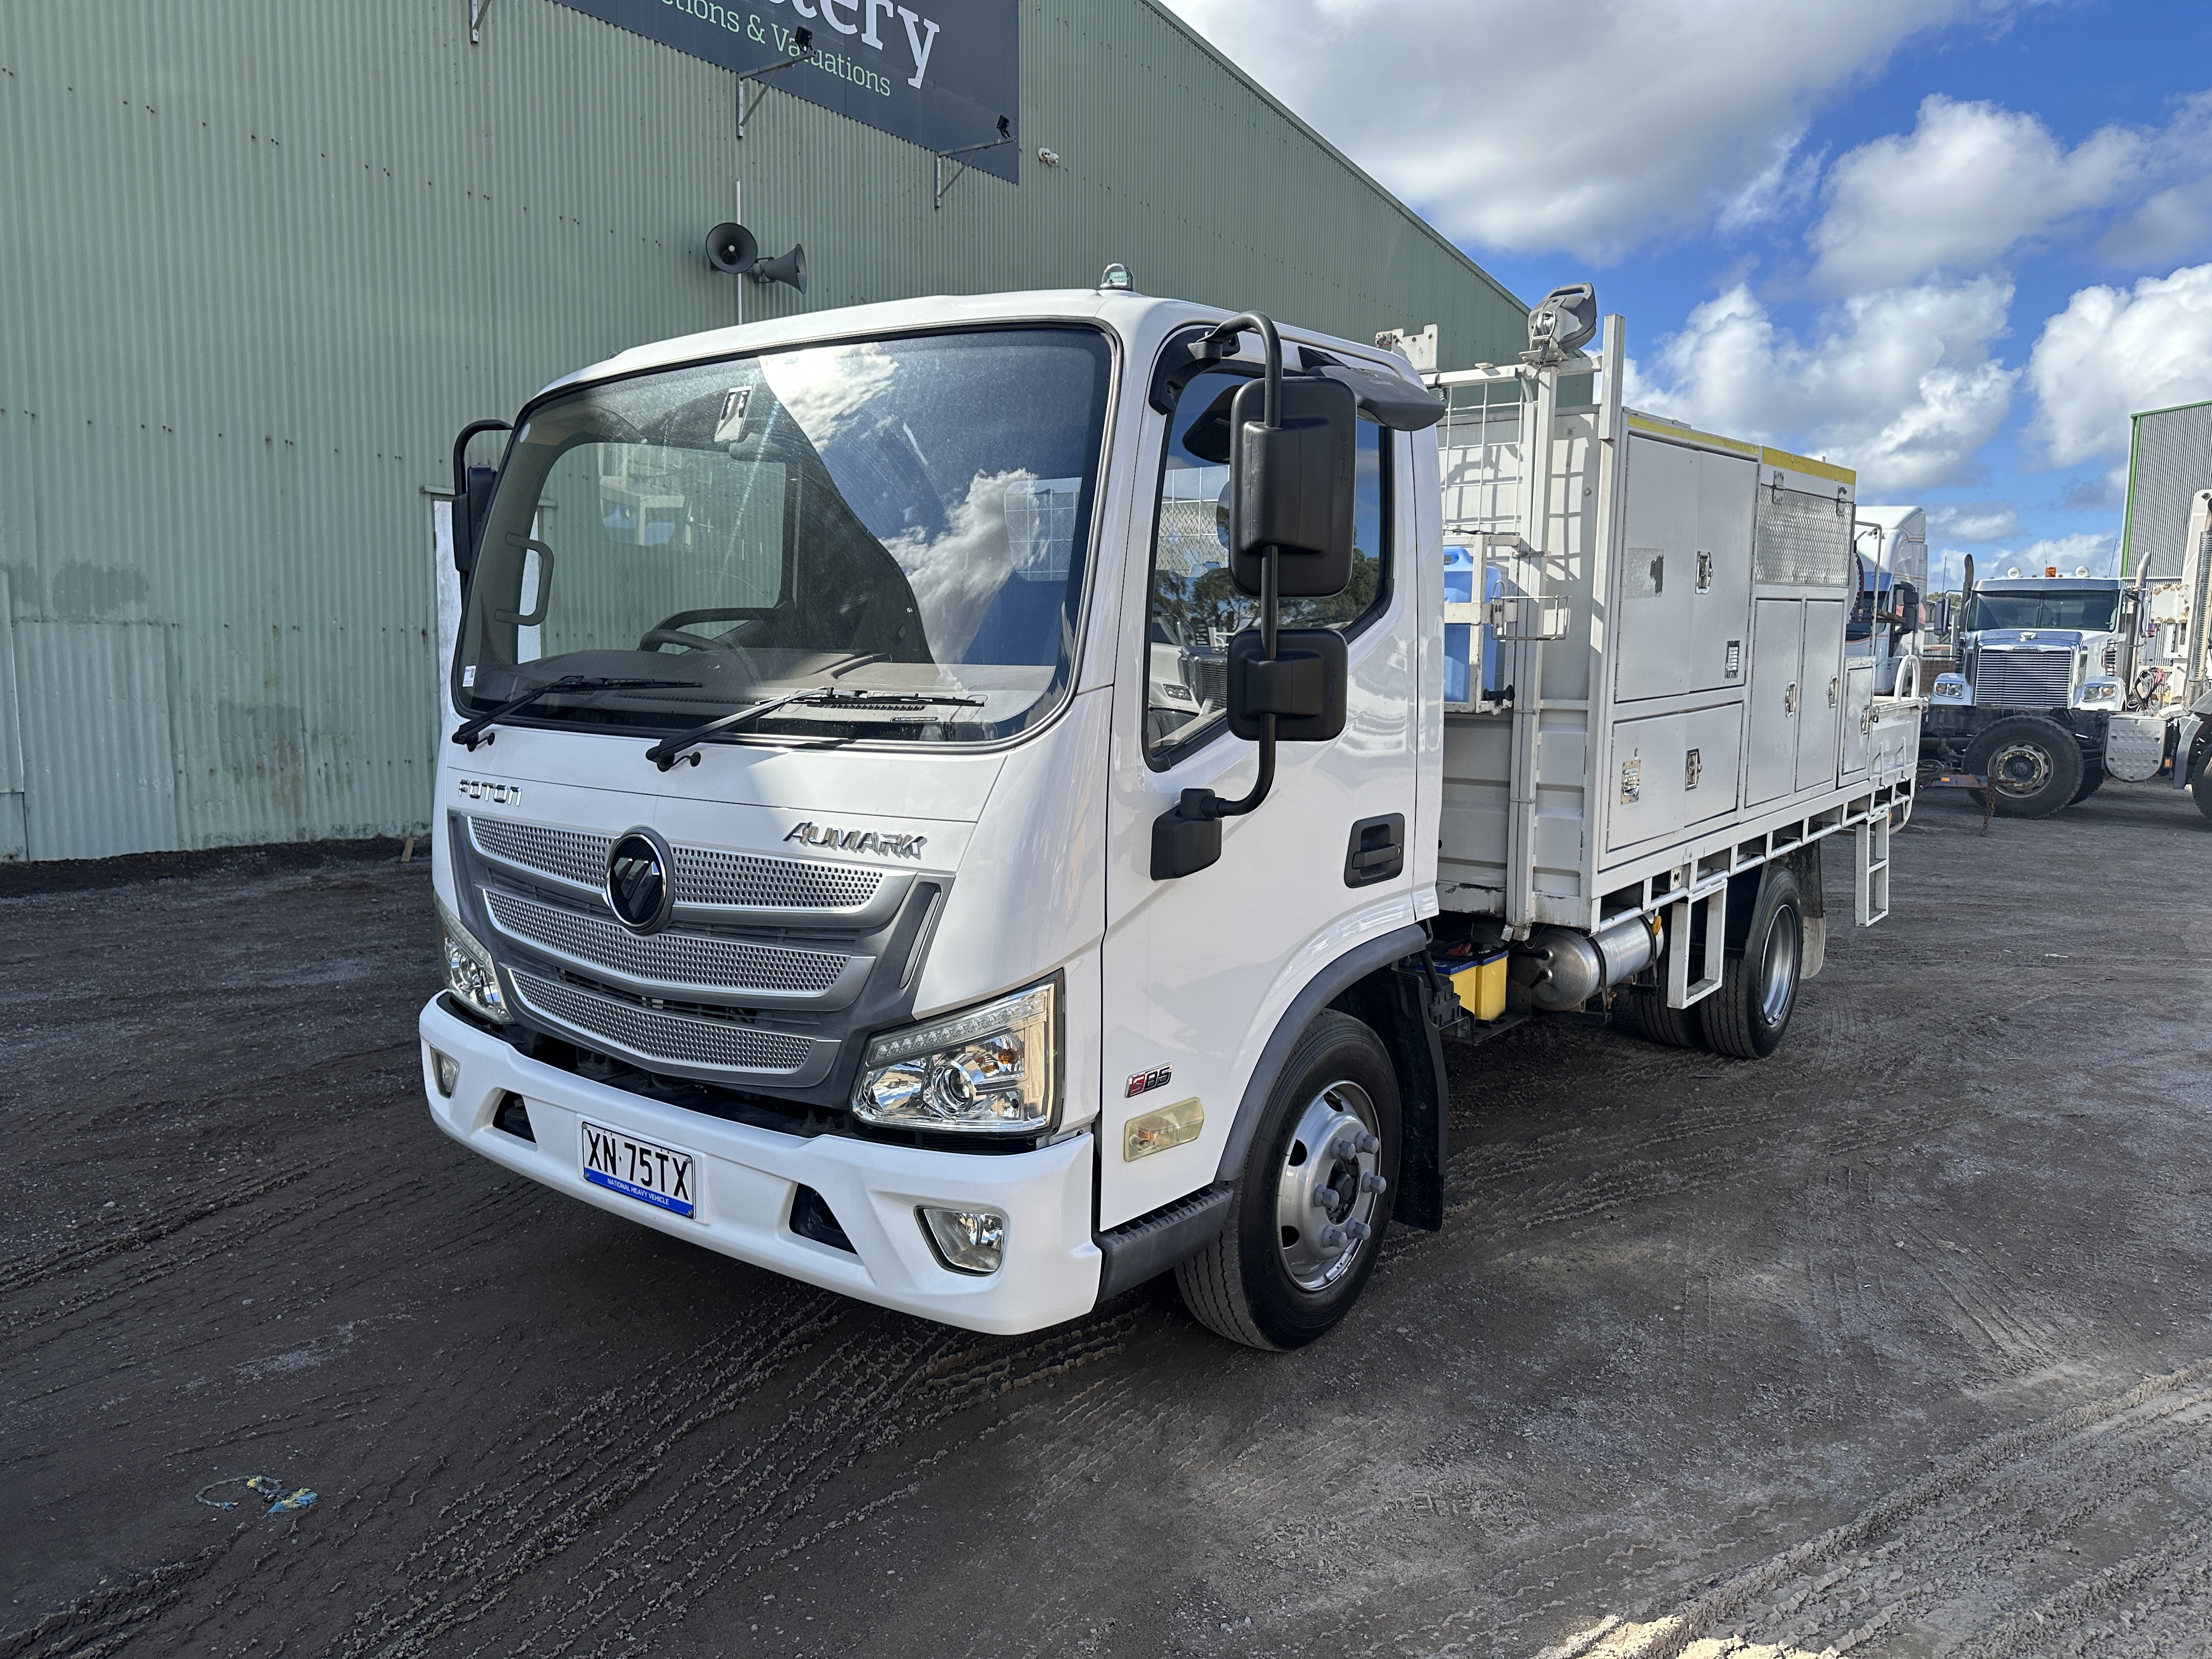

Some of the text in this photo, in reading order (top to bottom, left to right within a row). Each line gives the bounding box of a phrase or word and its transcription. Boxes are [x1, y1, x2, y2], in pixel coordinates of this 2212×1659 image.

[747, 14, 765, 44] &
[771, 23, 891, 97] Vauations
[2111, 747, 2158, 755] VOLVO
[458, 779, 522, 806] FOTON
[782, 820, 925, 856] AUMARK
[1129, 1064, 1172, 1096] S85
[607, 1177, 670, 1206] NATIONAL HEAVY VEHICLE
